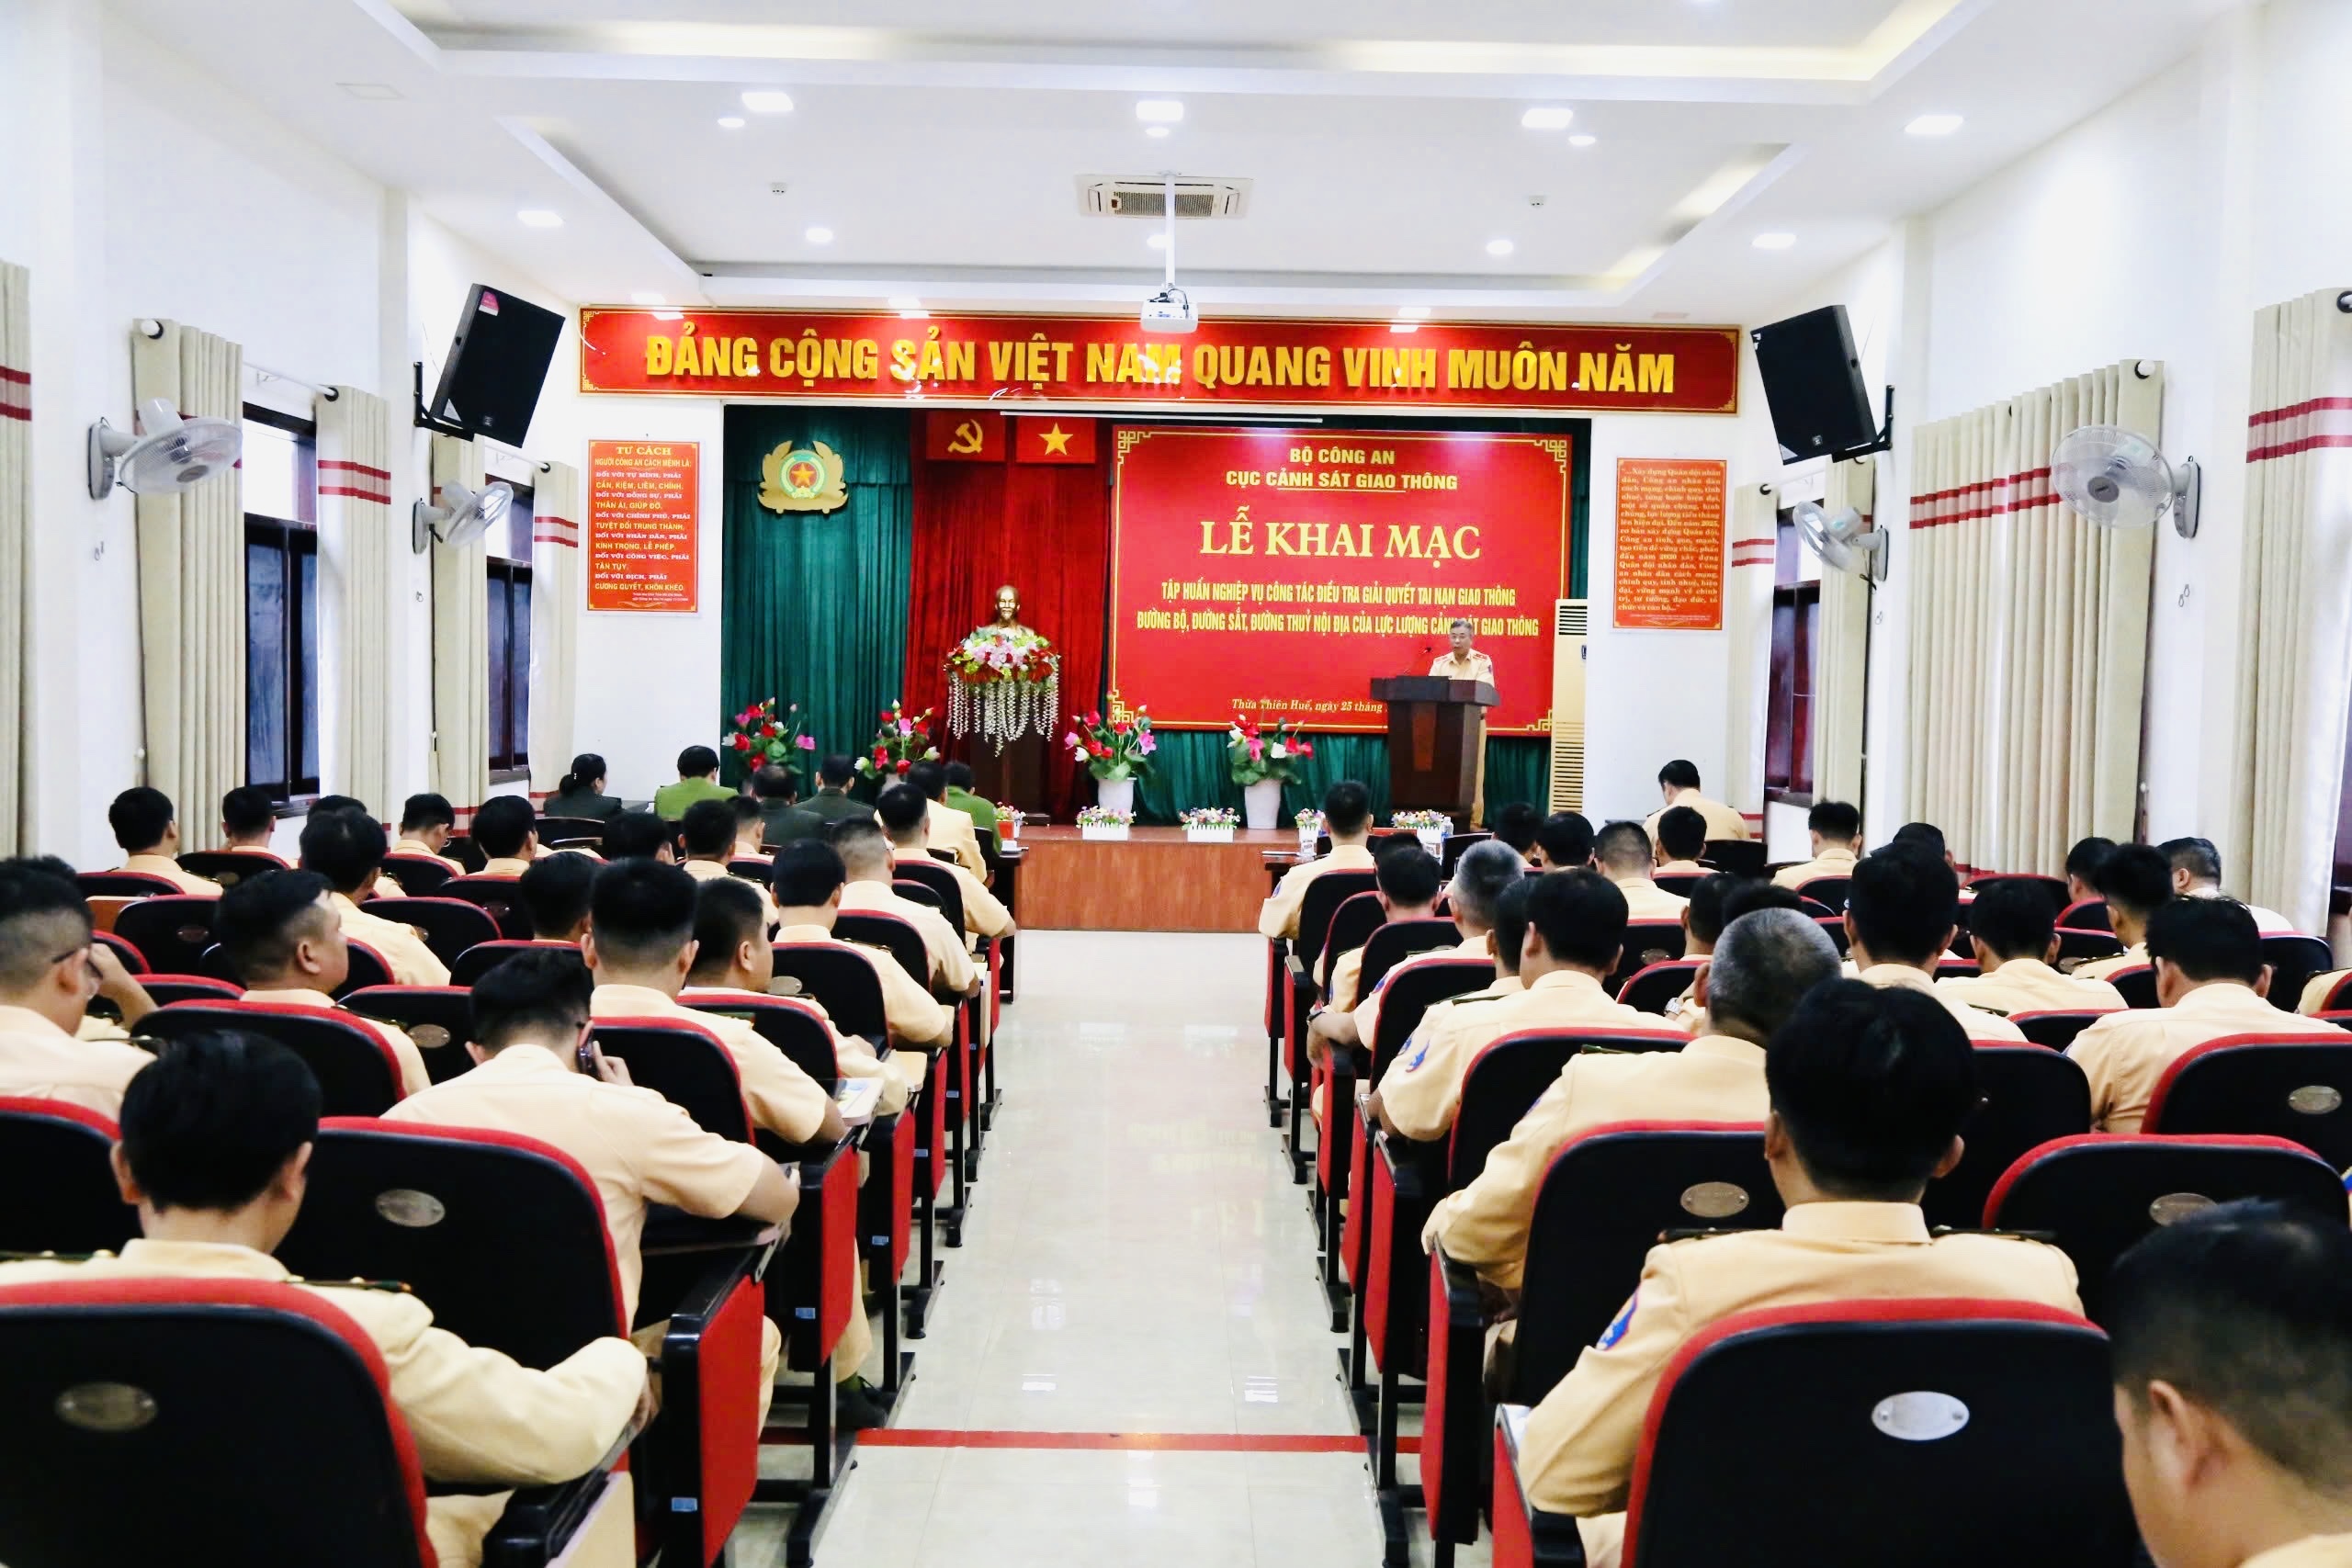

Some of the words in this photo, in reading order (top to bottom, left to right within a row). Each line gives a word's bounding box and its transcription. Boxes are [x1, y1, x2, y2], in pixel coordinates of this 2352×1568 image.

[647, 322, 758, 377] ĐẢNG
[770, 328, 877, 387] CỘNG
[890, 325, 976, 381] SẢN
[989, 333, 1074, 389] VIỆT
[1086, 343, 1182, 384] NAM
[1194, 344, 1330, 389] QUANG
[1343, 346, 1436, 389] VINH
[1447, 340, 1567, 390] MUÔN
[1579, 343, 1675, 394] NĂM
[616, 446, 633, 455] TƯ
[636, 446, 672, 456] CÁCH
[1290, 446, 1313, 466] BỘ
[1318, 446, 1365, 464] CÔNG
[1370, 450, 1395, 465] AN
[1226, 471, 1261, 490] CỤC
[1266, 467, 1313, 487] CẢNH
[1318, 470, 1351, 488] SÁT
[1355, 474, 1396, 489] GIAO
[1401, 472, 1458, 490] THÔNG
[1200, 505, 1254, 557] LỄ
[1265, 522, 1374, 558] KHAI
[1385, 525, 1481, 569] MẠC
[1161, 579, 1181, 603] TẬP
[1182, 577, 1210, 601] HUẤN
[1212, 580, 1249, 604] NGHIỆP
[1251, 584, 1264, 605] VỤ
[1266, 581, 1294, 603] CÔNG
[1295, 581, 1315, 603] TÁC
[1317, 580, 1340, 604] ĐIỀU
[1342, 585, 1360, 604] TRA
[1363, 581, 1383, 604] GIẢI
[1385, 581, 1415, 606] QUYẾT
[1419, 588, 1432, 605] TAI
[1434, 588, 1455, 609] NẠN
[1458, 589, 1481, 606] GIAO
[1484, 585, 1516, 606] THÔNG
[1137, 607, 1171, 629] ĐƯỜNG
[1173, 609, 1189, 632] BỘ,
[1192, 609, 1226, 630] ĐƯỜNG
[1228, 607, 1249, 632] SẮT,
[1250, 610, 1284, 631] ĐƯỜNG
[1286, 609, 1311, 632] THUỶ
[1314, 611, 1330, 636] NỘI
[1333, 615, 1350, 637] ĐỊA
[1352, 610, 1372, 634] CỦA
[1375, 615, 1394, 637] LỰC
[1396, 615, 1428, 637] LƯỢNG
[1481, 618, 1504, 636] GIAO
[1507, 615, 1539, 637] THÔNG
[1232, 698, 1257, 709] Thừa
[1260, 699, 1287, 710] Thiên
[1290, 699, 1313, 711] Huế,
[1315, 701, 1339, 714] ngày
[1340, 702, 1352, 712] 25
[1354, 702, 1383, 714] tháng
